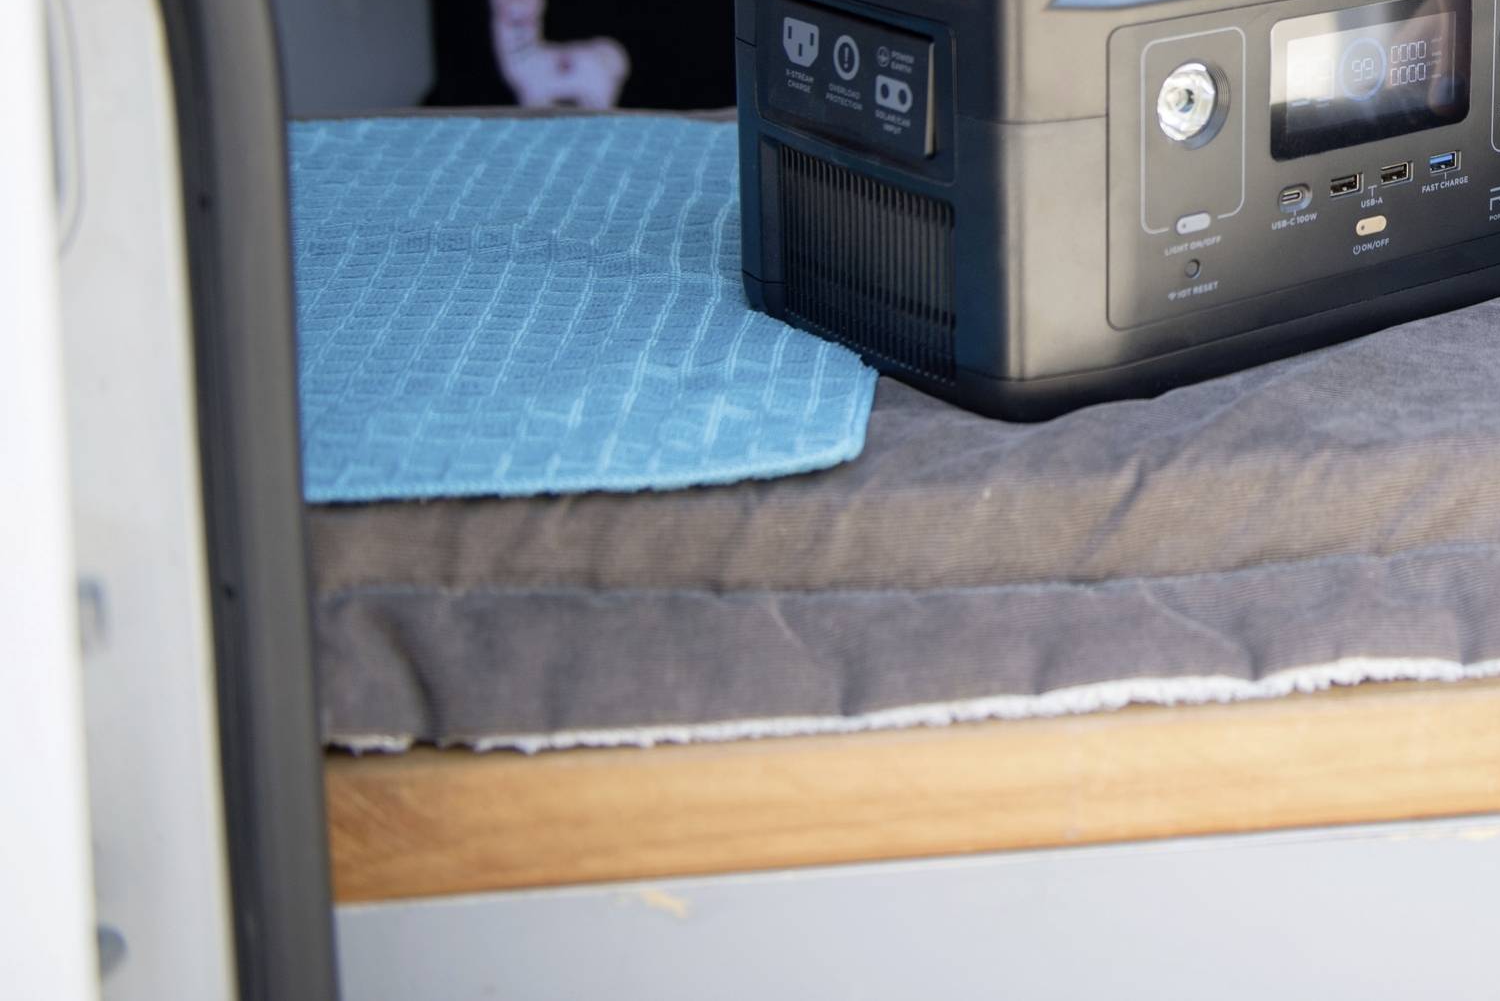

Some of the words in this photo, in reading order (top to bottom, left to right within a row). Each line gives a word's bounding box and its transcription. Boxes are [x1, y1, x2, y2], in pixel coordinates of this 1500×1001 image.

[787, 79, 812, 94] CHARGE
[828, 83, 861, 99] OVERLOAD
[826, 92, 863, 110] PROTECTION
[1421, 182, 1439, 194] FAST
[1440, 176, 1469, 189] CHARGE
[1360, 197, 1384, 209] USB-A
[1271, 218, 1296, 231] USB-C
[1296, 212, 1318, 225] 100W
[1165, 242, 1188, 256] LIGHT
[1190, 236, 1221, 249] ON/OFF
[1361, 238, 1390, 251] ON/OFF
[1192, 281, 1219, 295] RESET
